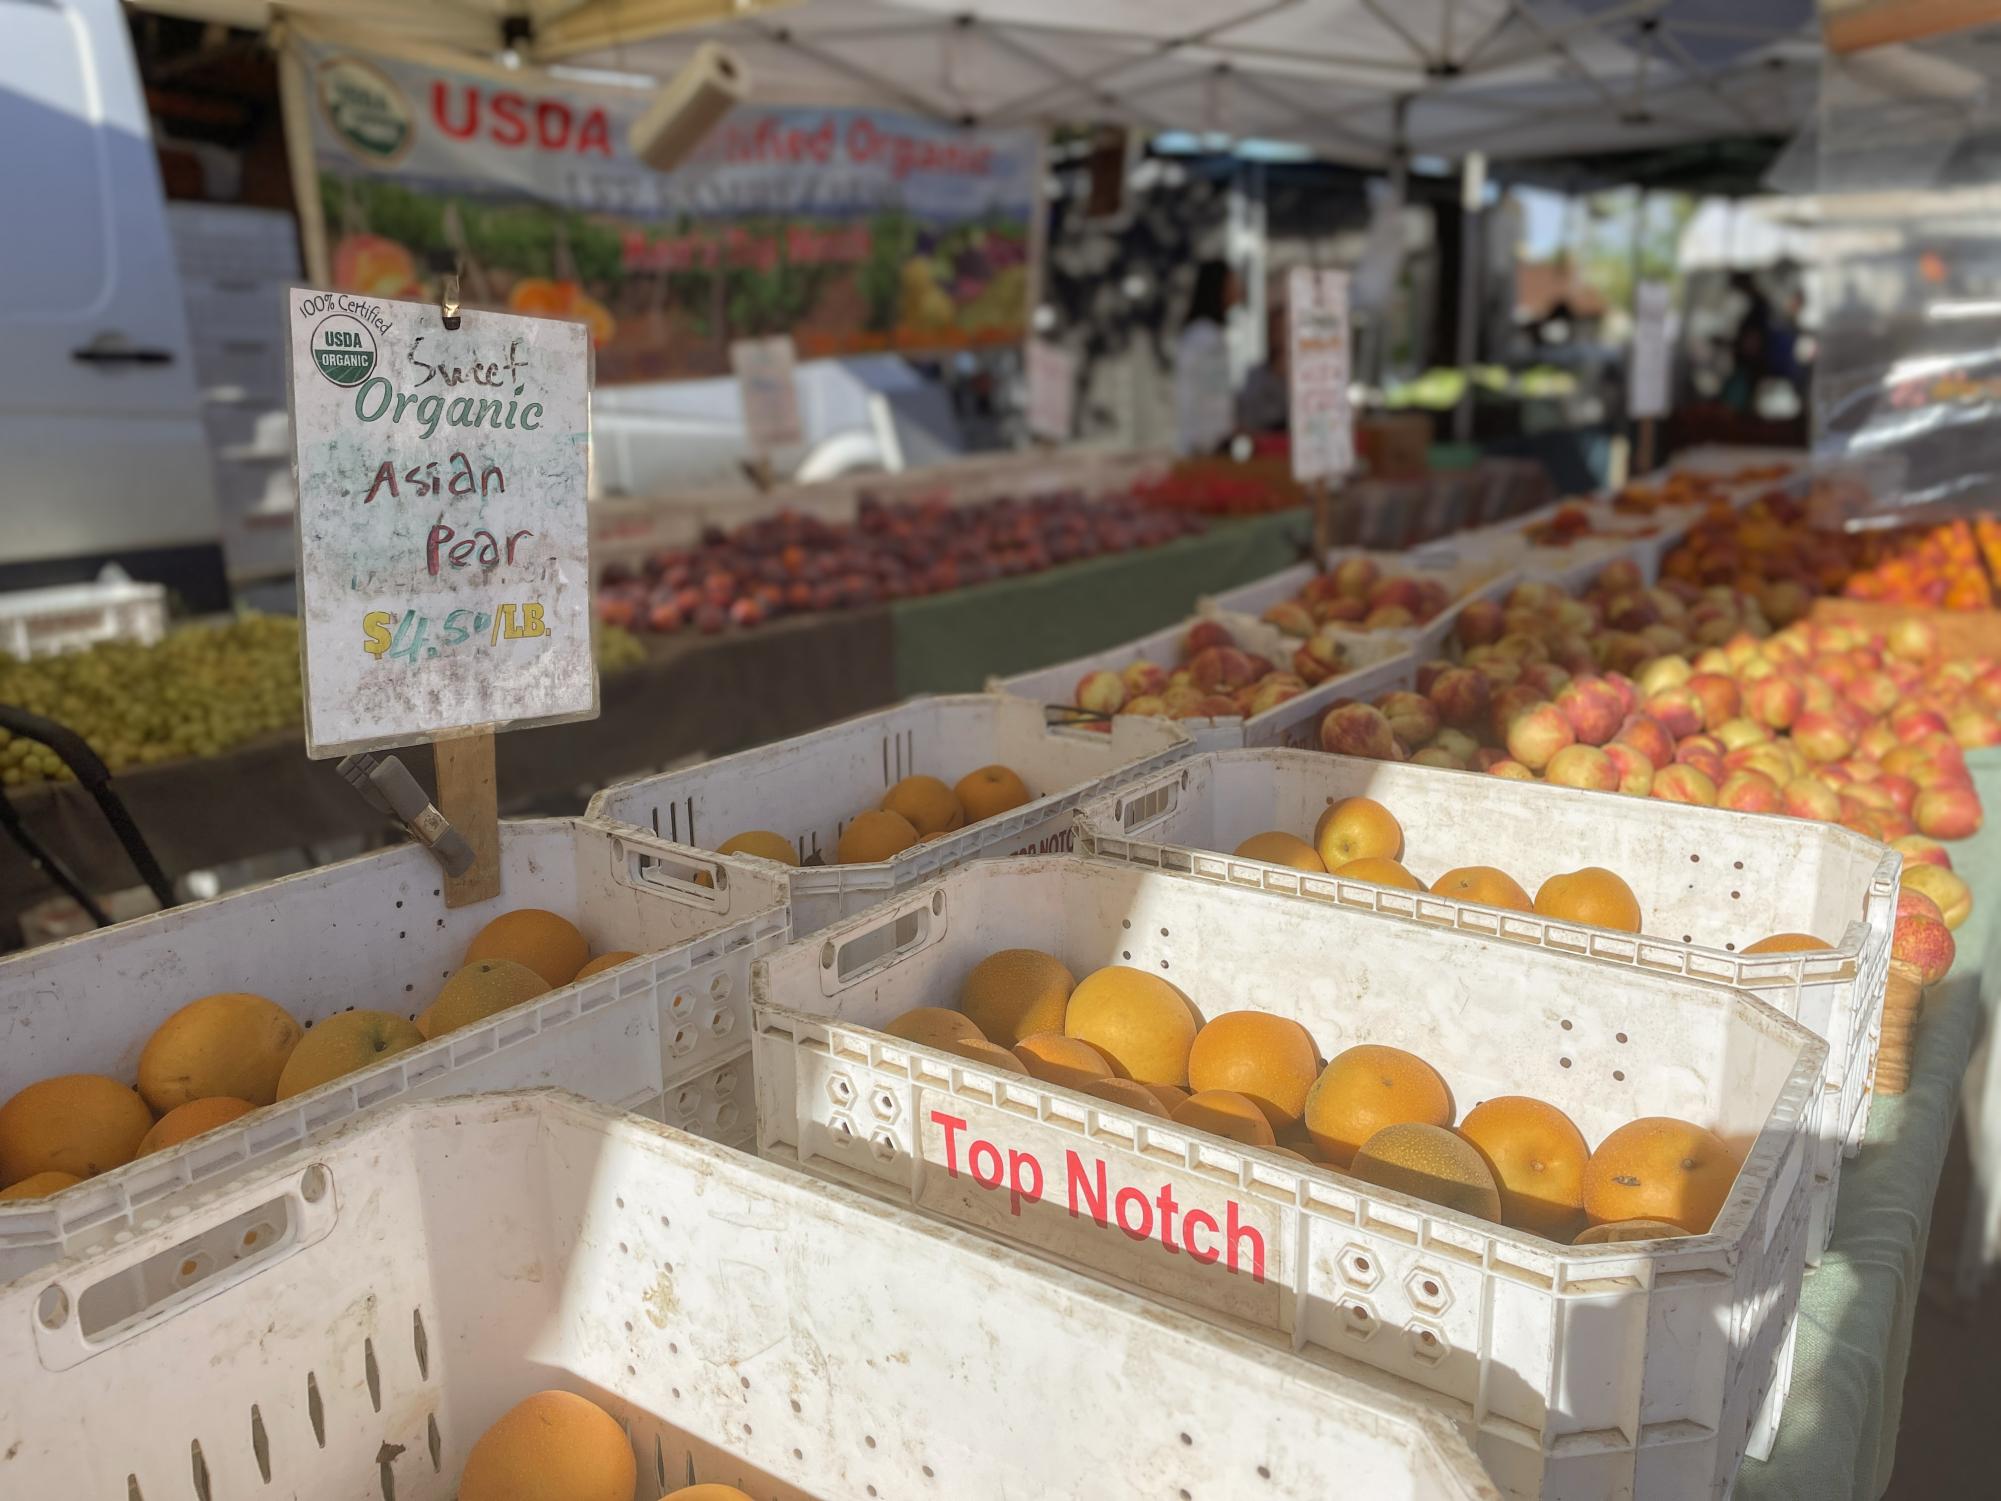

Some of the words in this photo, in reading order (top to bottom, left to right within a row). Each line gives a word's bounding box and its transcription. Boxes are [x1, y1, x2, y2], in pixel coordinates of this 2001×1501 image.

[431, 80, 615, 158] USDA
[299, 294, 336, 319] 100%
[338, 294, 393, 336] Certified
[324, 330, 363, 349] USDA
[321, 353, 369, 367] ORGANIC
[407, 336, 529, 388] Sweet
[354, 376, 544, 440] Organic
[363, 451, 506, 504] Asian
[426, 524, 535, 577] Pear
[930, 1110, 1044, 1217] Top
[1065, 1148, 1265, 1285] Notch
